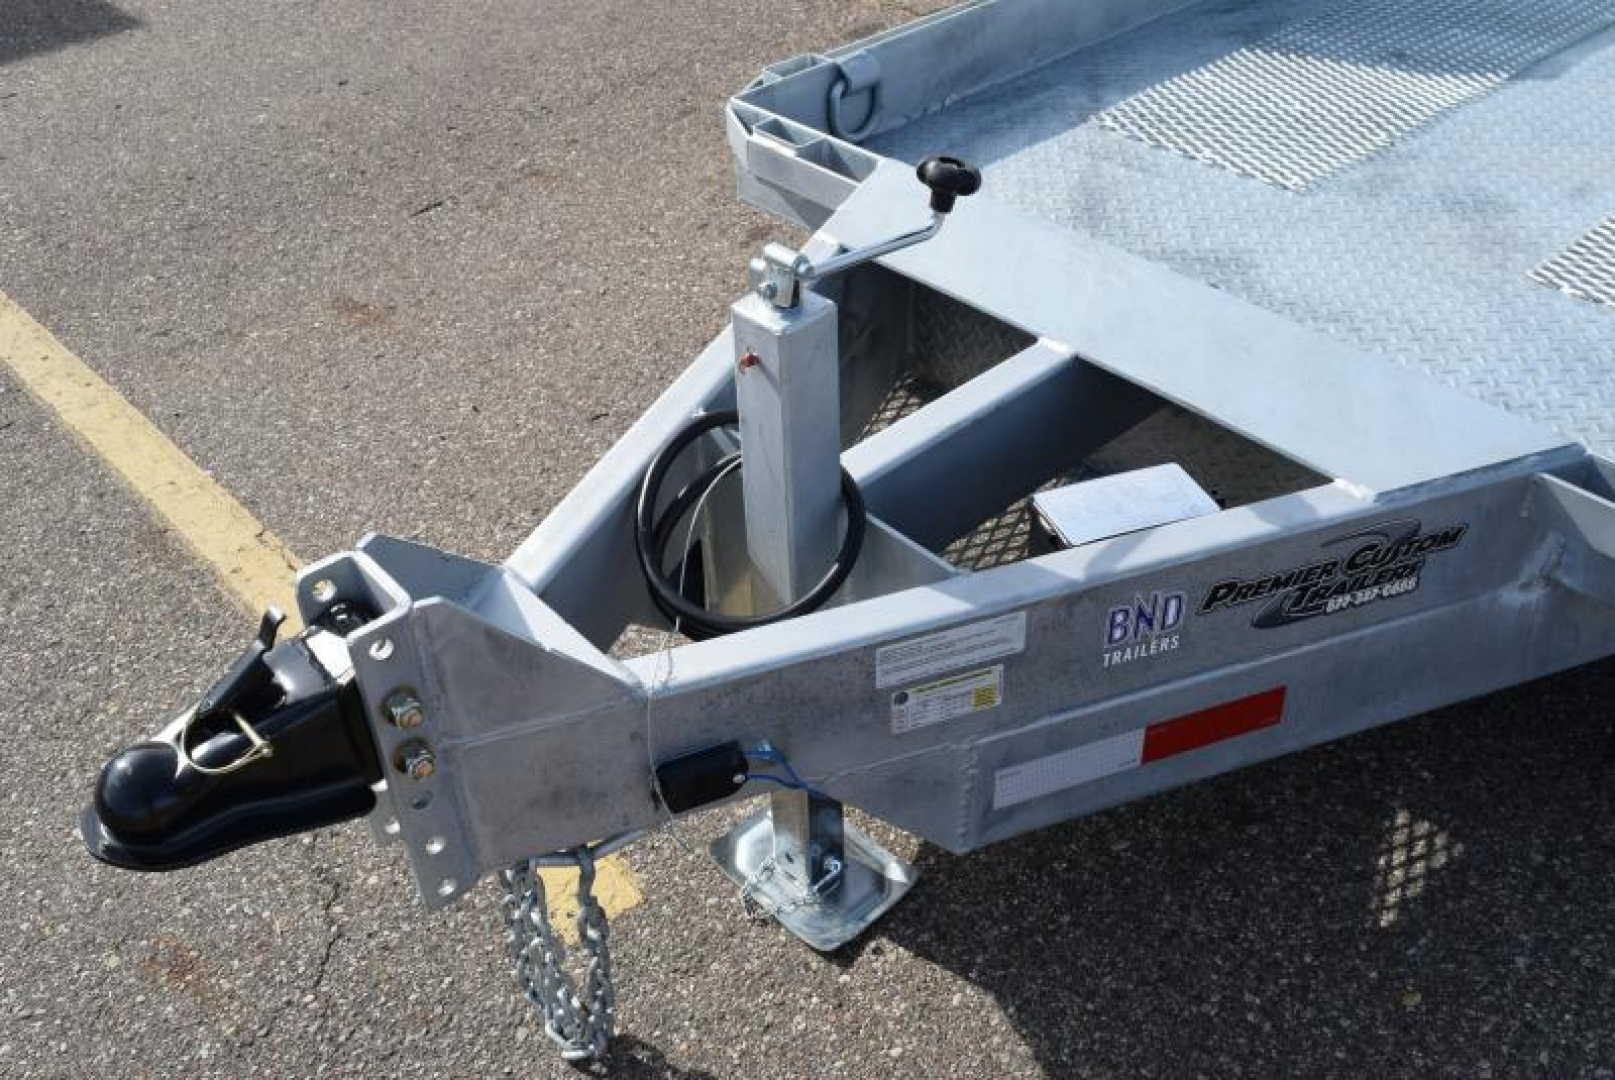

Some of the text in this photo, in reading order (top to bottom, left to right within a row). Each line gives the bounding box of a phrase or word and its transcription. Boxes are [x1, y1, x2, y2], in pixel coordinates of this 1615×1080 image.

[1197, 560, 1338, 615] PREMIER
[1105, 592, 1186, 647] BND
[1103, 635, 1180, 667] TRAILERS
